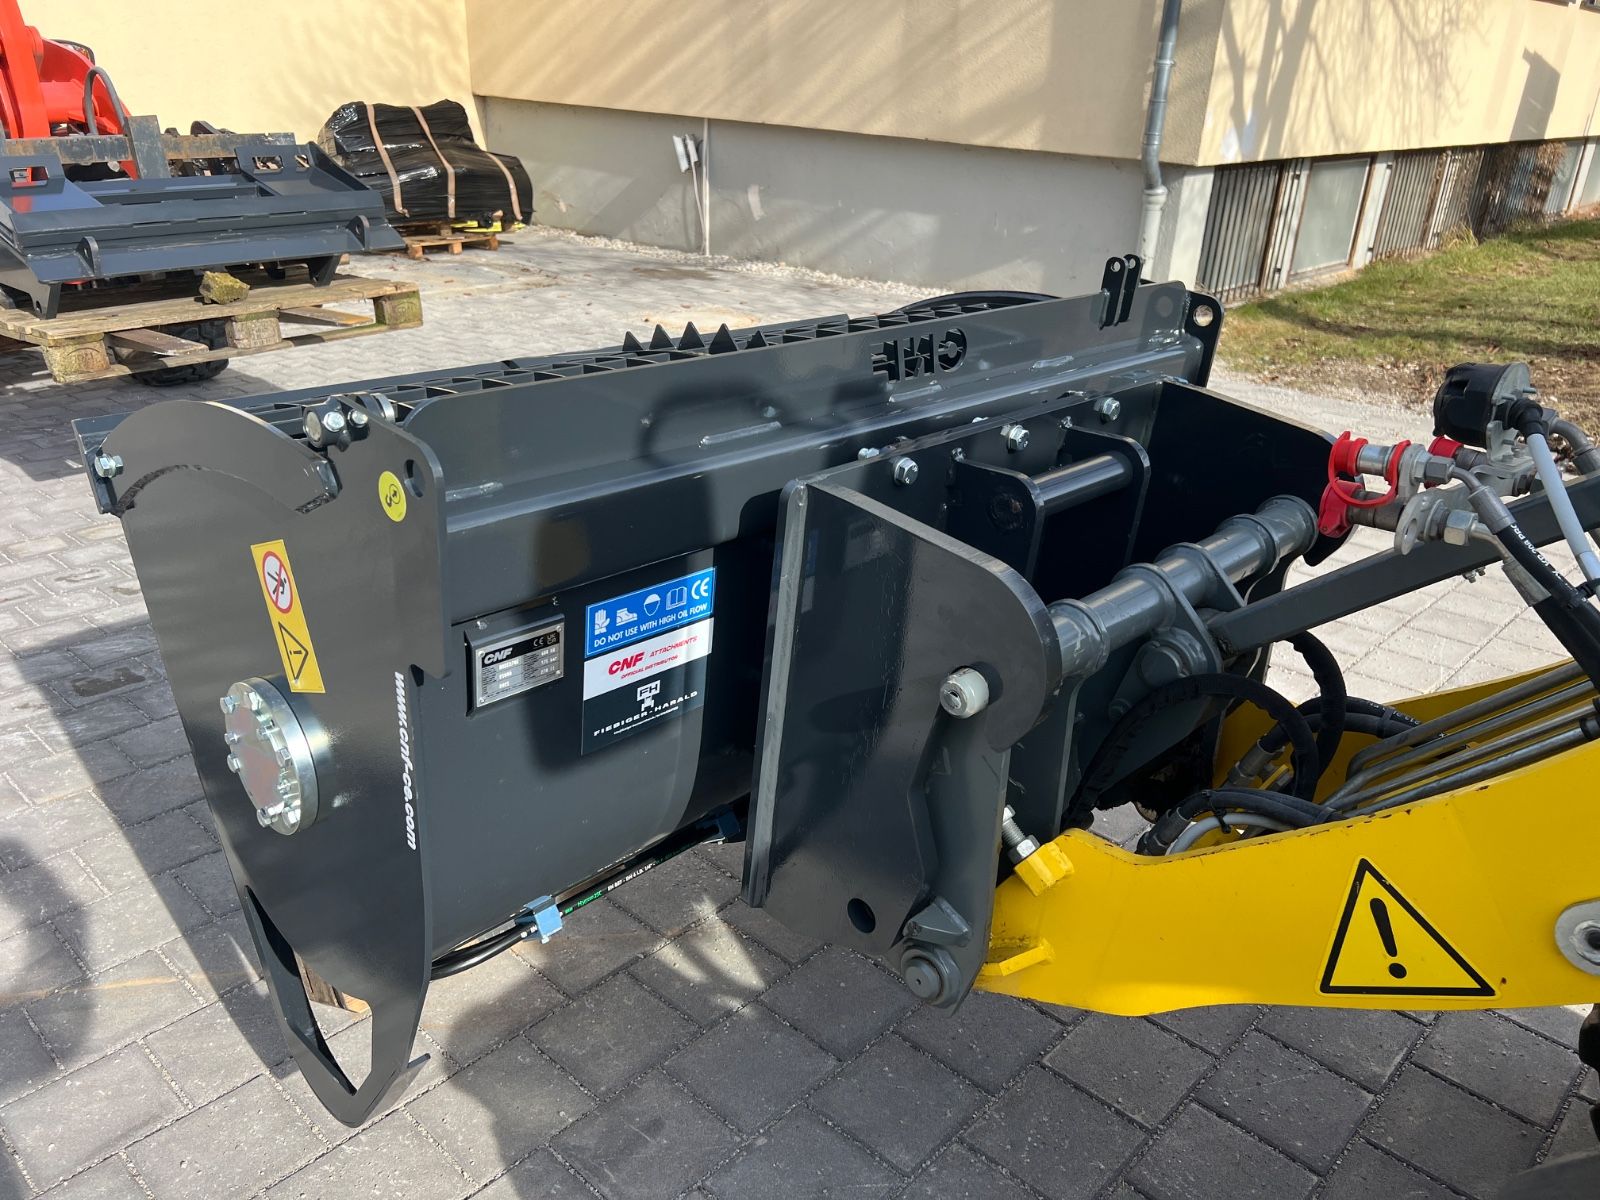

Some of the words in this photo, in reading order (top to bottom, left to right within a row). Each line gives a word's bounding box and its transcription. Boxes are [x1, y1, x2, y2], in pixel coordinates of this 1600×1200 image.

[594, 637, 606, 648] DO
[607, 631, 624, 643] NOT
[625, 626, 639, 637] USE
[640, 619, 658, 632] WITH
[659, 613, 677, 625] HIGH
[677, 610, 689, 619] OIL
[689, 603, 708, 615] FLOW
[483, 647, 513, 665] CNF
[608, 651, 646, 675] CNF
[649, 636, 699, 658] ATTACHMENTS
[621, 667, 644, 679] OFFICIAL
[394, 671, 417, 851] www.cnf-ce.com
